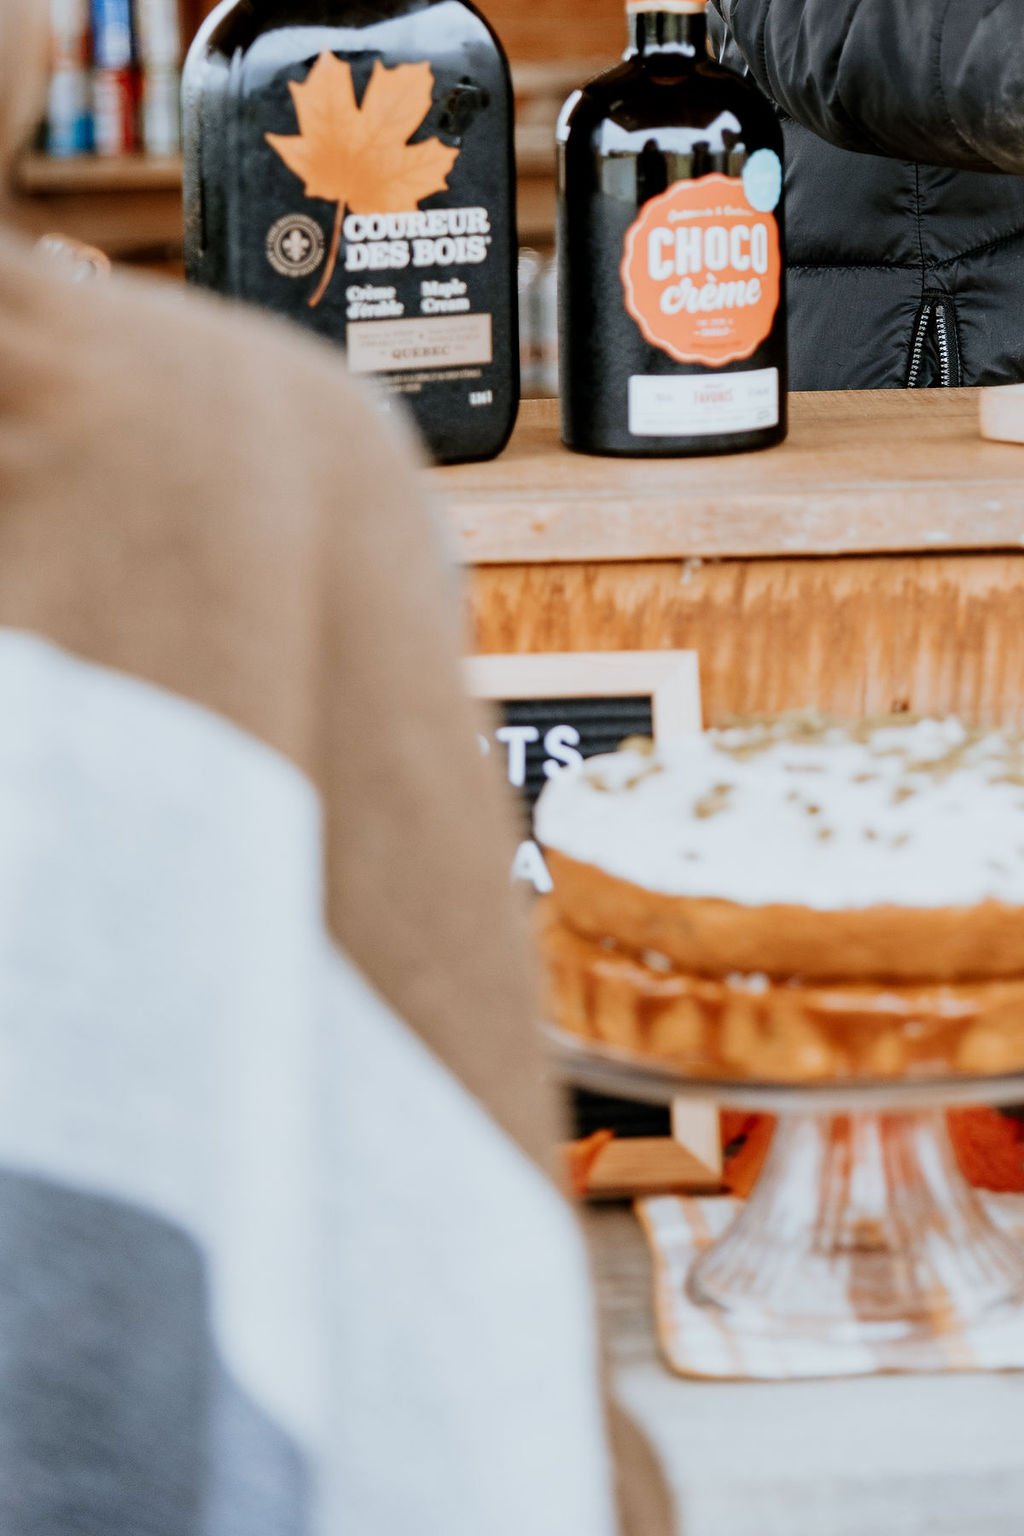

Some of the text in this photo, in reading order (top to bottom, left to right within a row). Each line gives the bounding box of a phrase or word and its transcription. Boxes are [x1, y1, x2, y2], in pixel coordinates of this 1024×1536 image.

[343, 207, 490, 241] COUREUR
[345, 239, 410, 271] DES
[412, 235, 487, 267] BOIS
[648, 223, 768, 281] CHOCO
[421, 278, 467, 298] Maple
